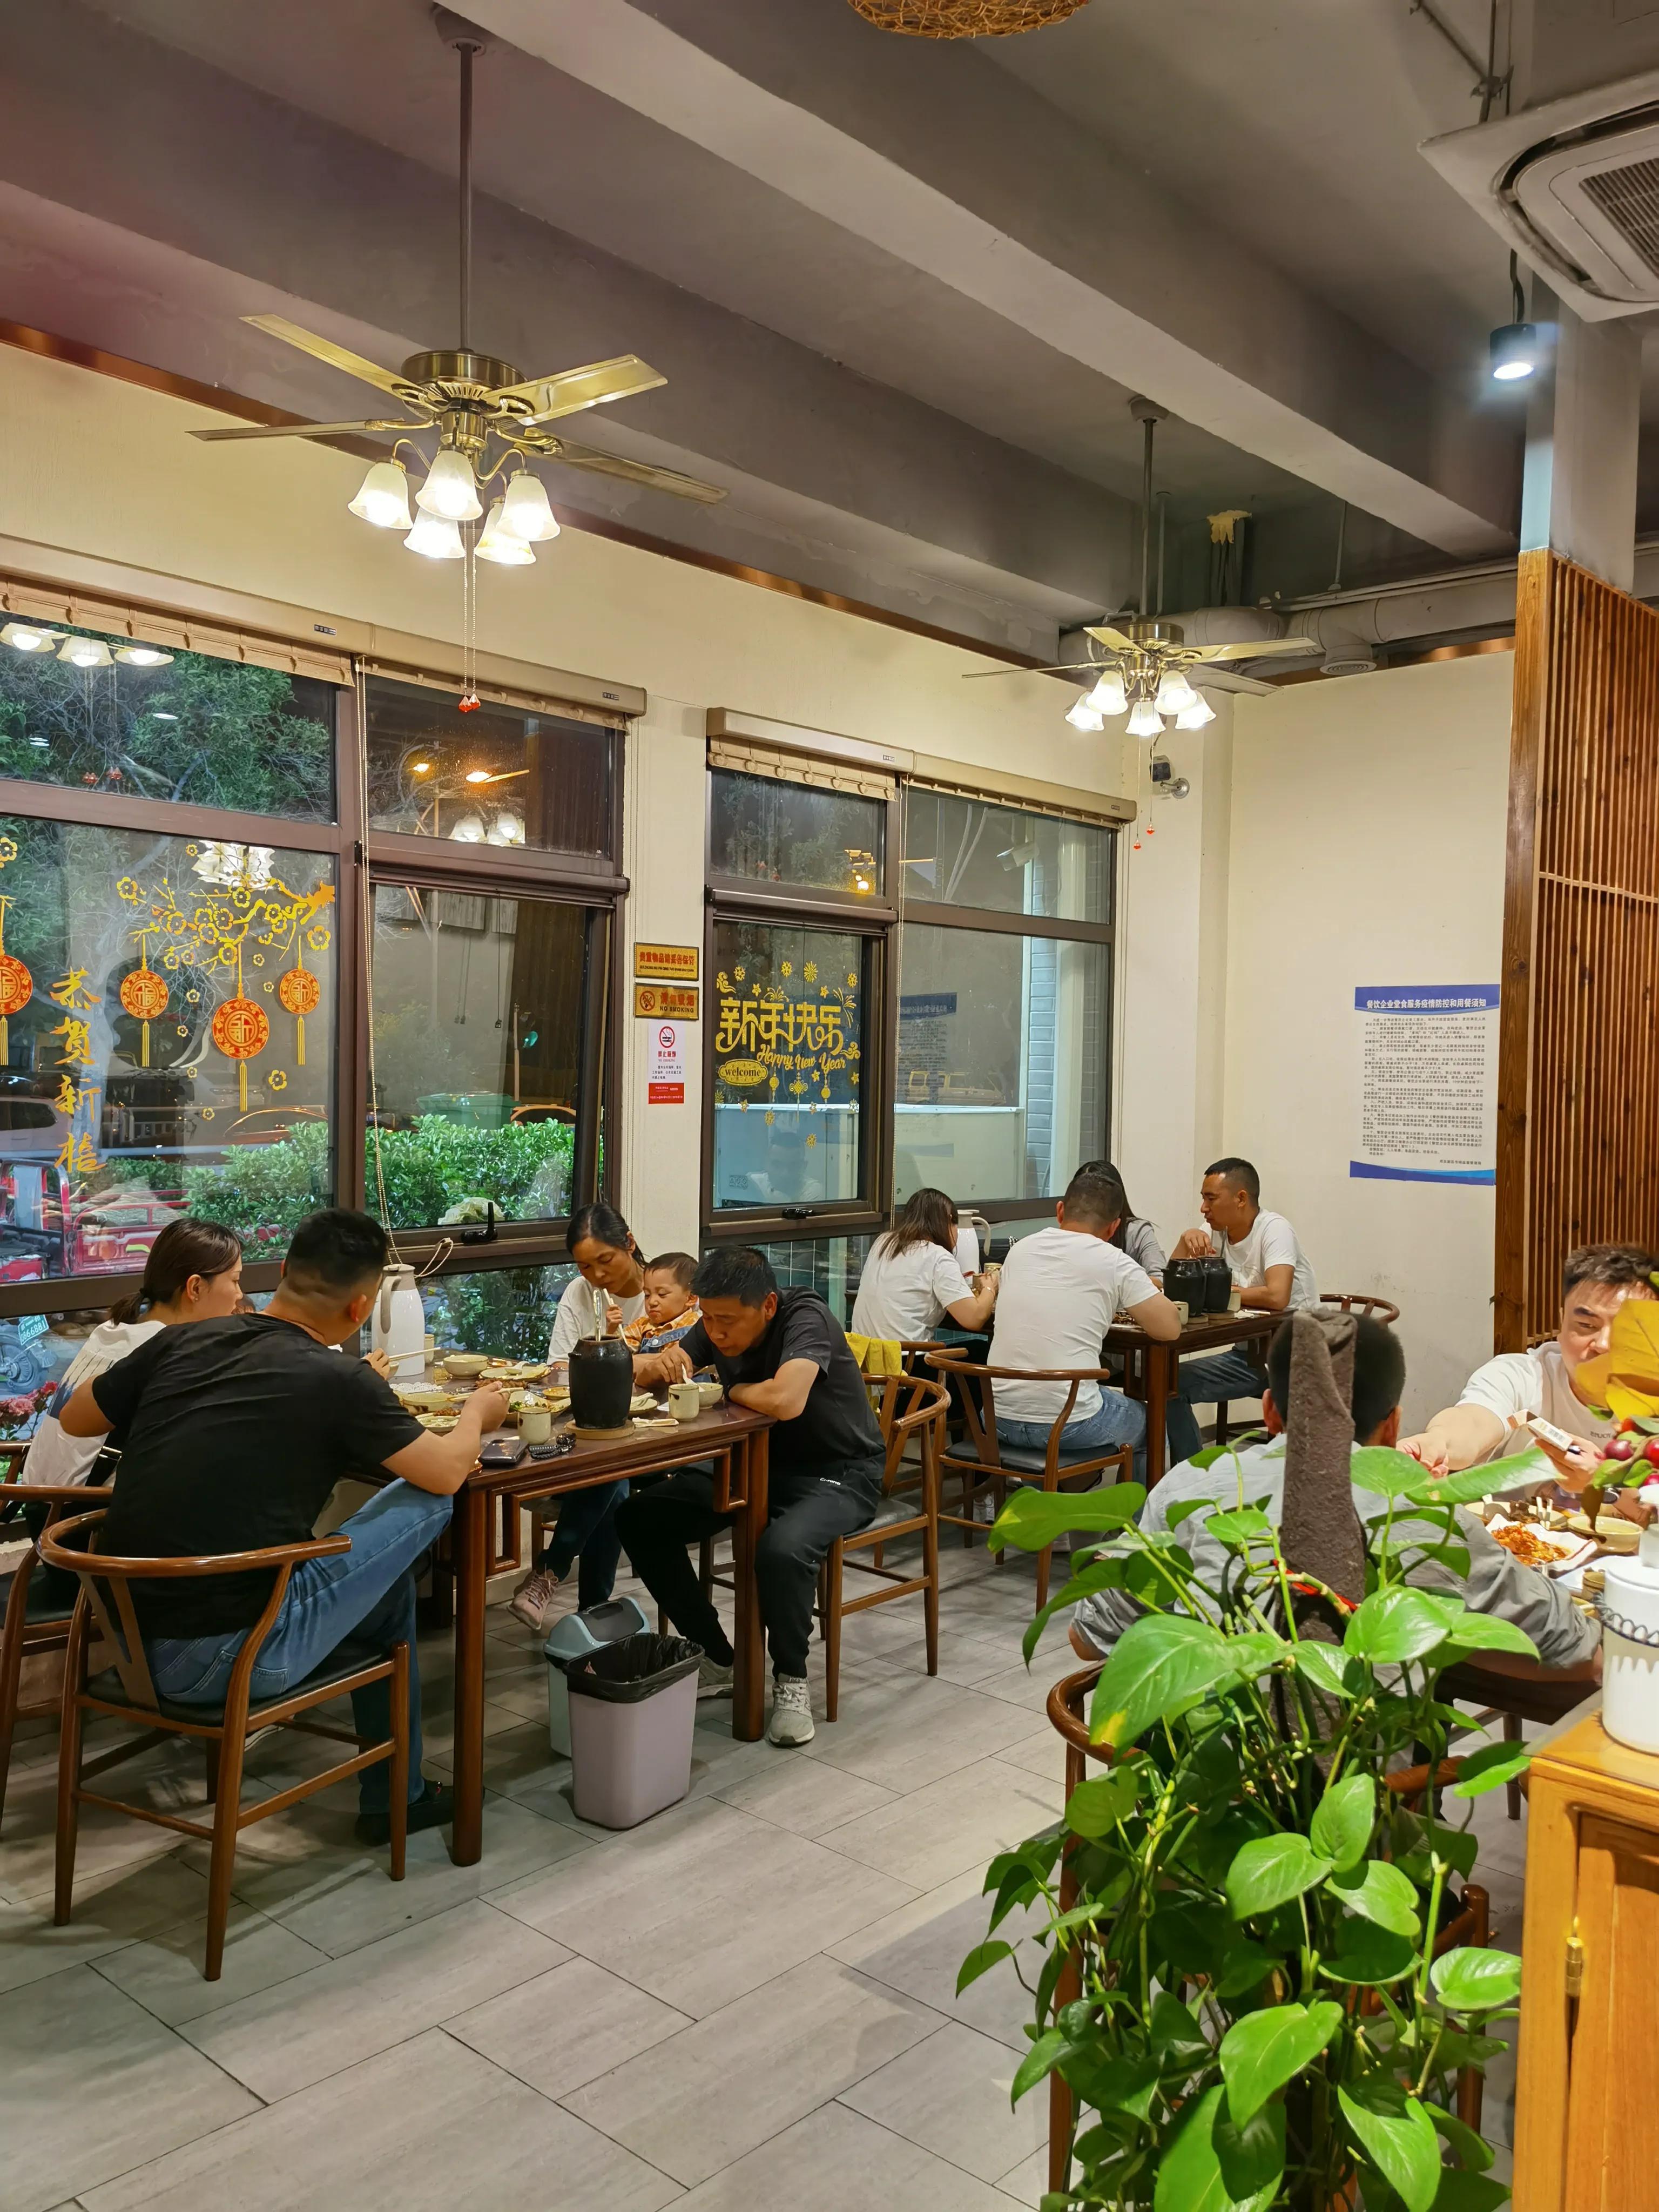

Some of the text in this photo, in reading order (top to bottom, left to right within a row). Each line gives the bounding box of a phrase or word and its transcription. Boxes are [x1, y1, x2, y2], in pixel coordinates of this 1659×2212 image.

[716, 997, 844, 1056] 新年快乐
[725, 1067, 761, 1077] welcome
[757, 1044, 846, 1074] Happy New Year
